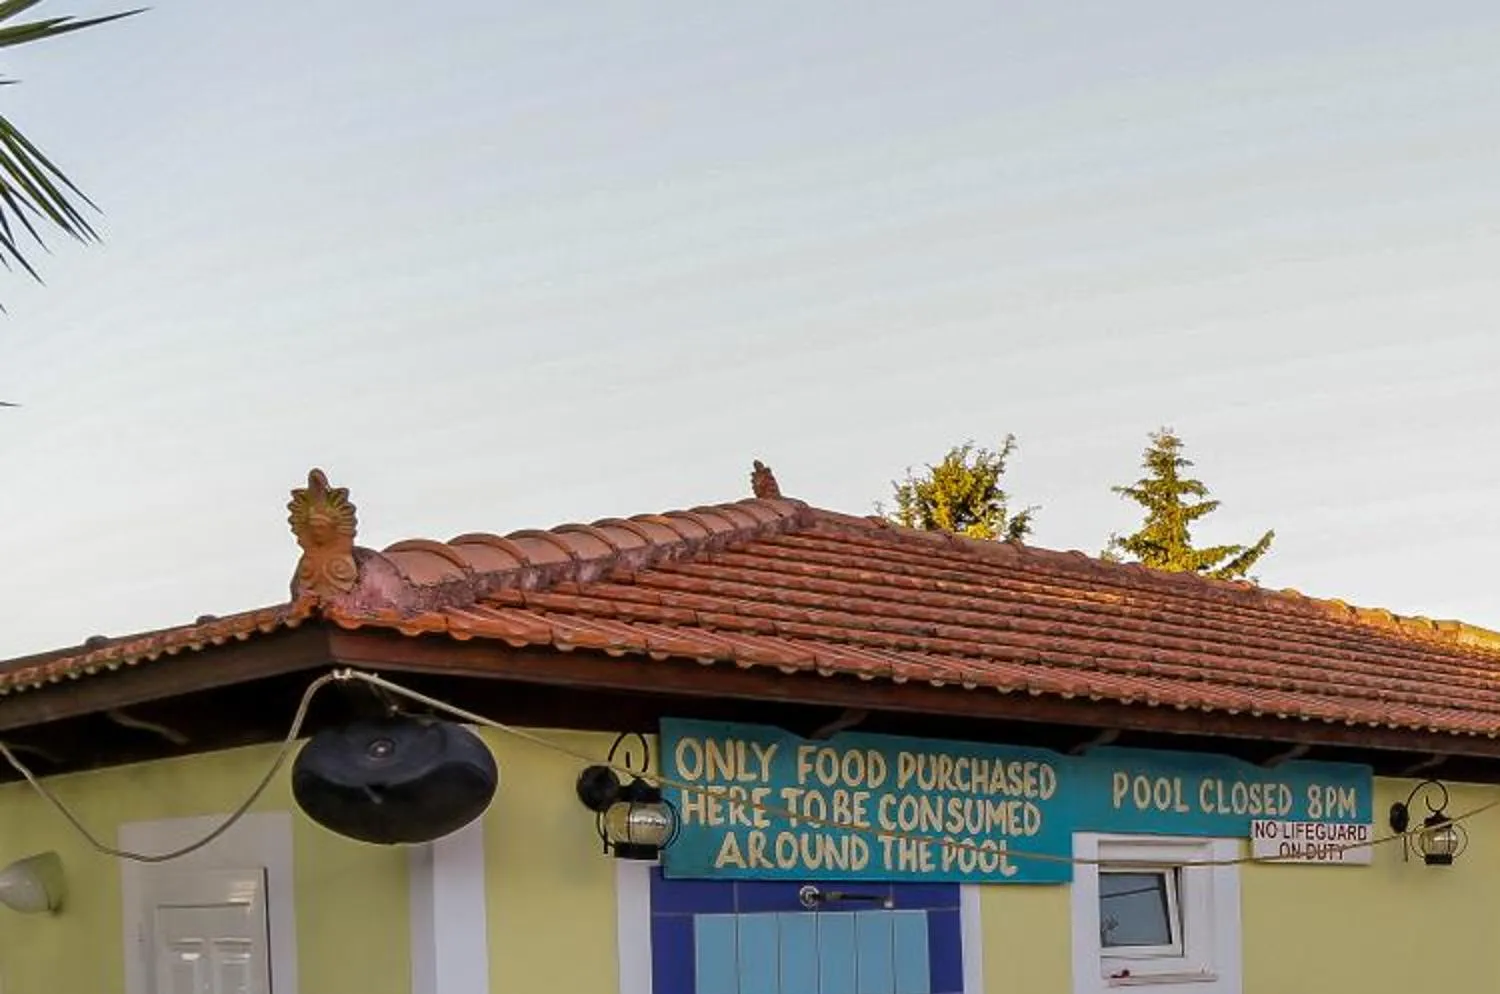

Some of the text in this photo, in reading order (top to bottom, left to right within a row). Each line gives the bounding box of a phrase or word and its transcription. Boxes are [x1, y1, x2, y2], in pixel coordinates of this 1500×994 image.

[675, 737, 1057, 800] ONLY FOOD PURCHASED
[681, 786, 1041, 836] HERE TO BE CONSUMED
[1113, 771, 1356, 819] POOL CLOSED 8PM
[715, 831, 1019, 877] AROUND THE POOL
[1255, 823, 1367, 841] NO LIFEGUARD
[1279, 842, 1345, 861] ON DUTY
